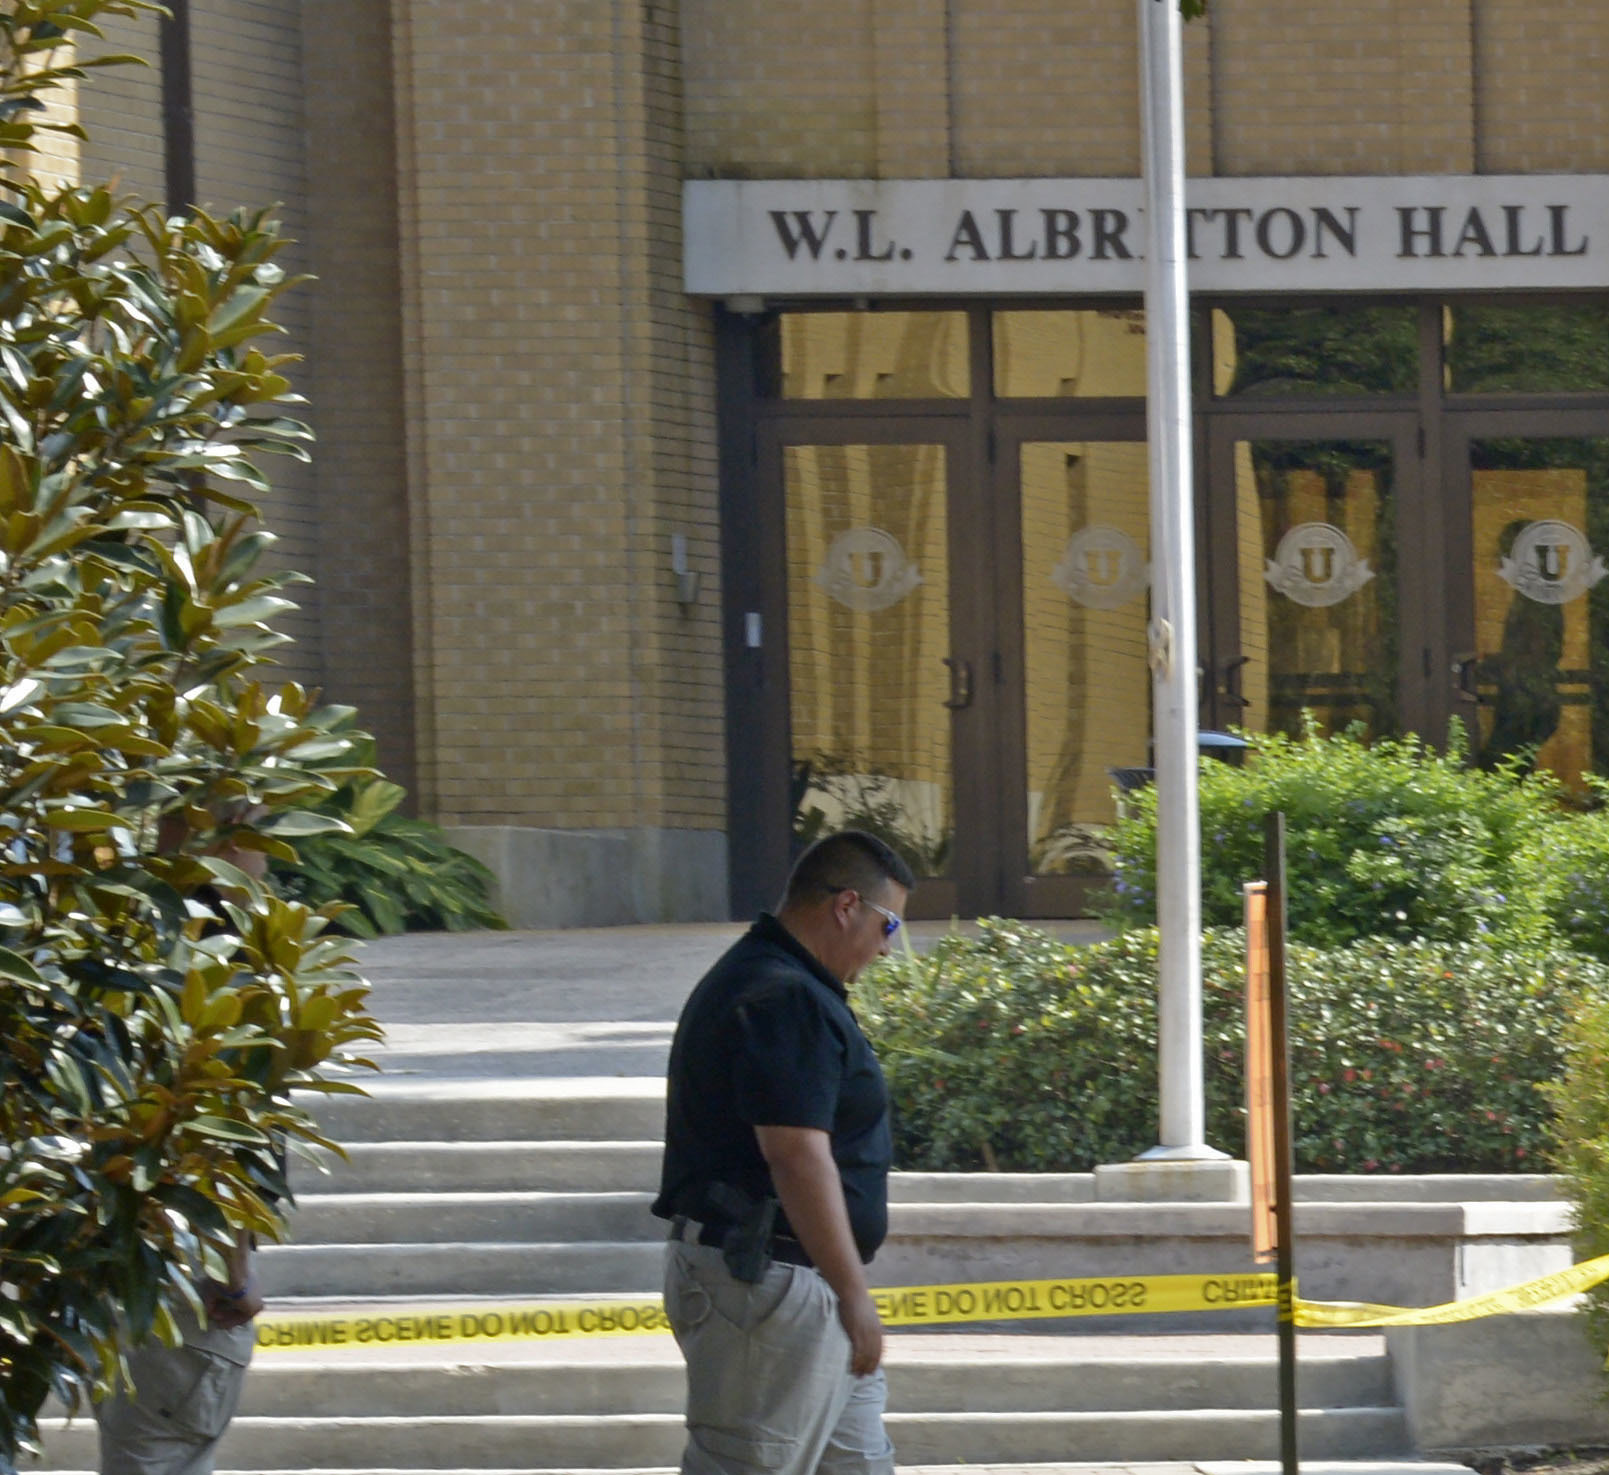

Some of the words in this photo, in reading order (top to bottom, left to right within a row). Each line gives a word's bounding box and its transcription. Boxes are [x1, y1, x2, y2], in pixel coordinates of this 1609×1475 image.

[767, 208, 912, 261] W.L.
[944, 206, 1361, 261] ALBRTTON
[1394, 205, 1589, 257] HALL
